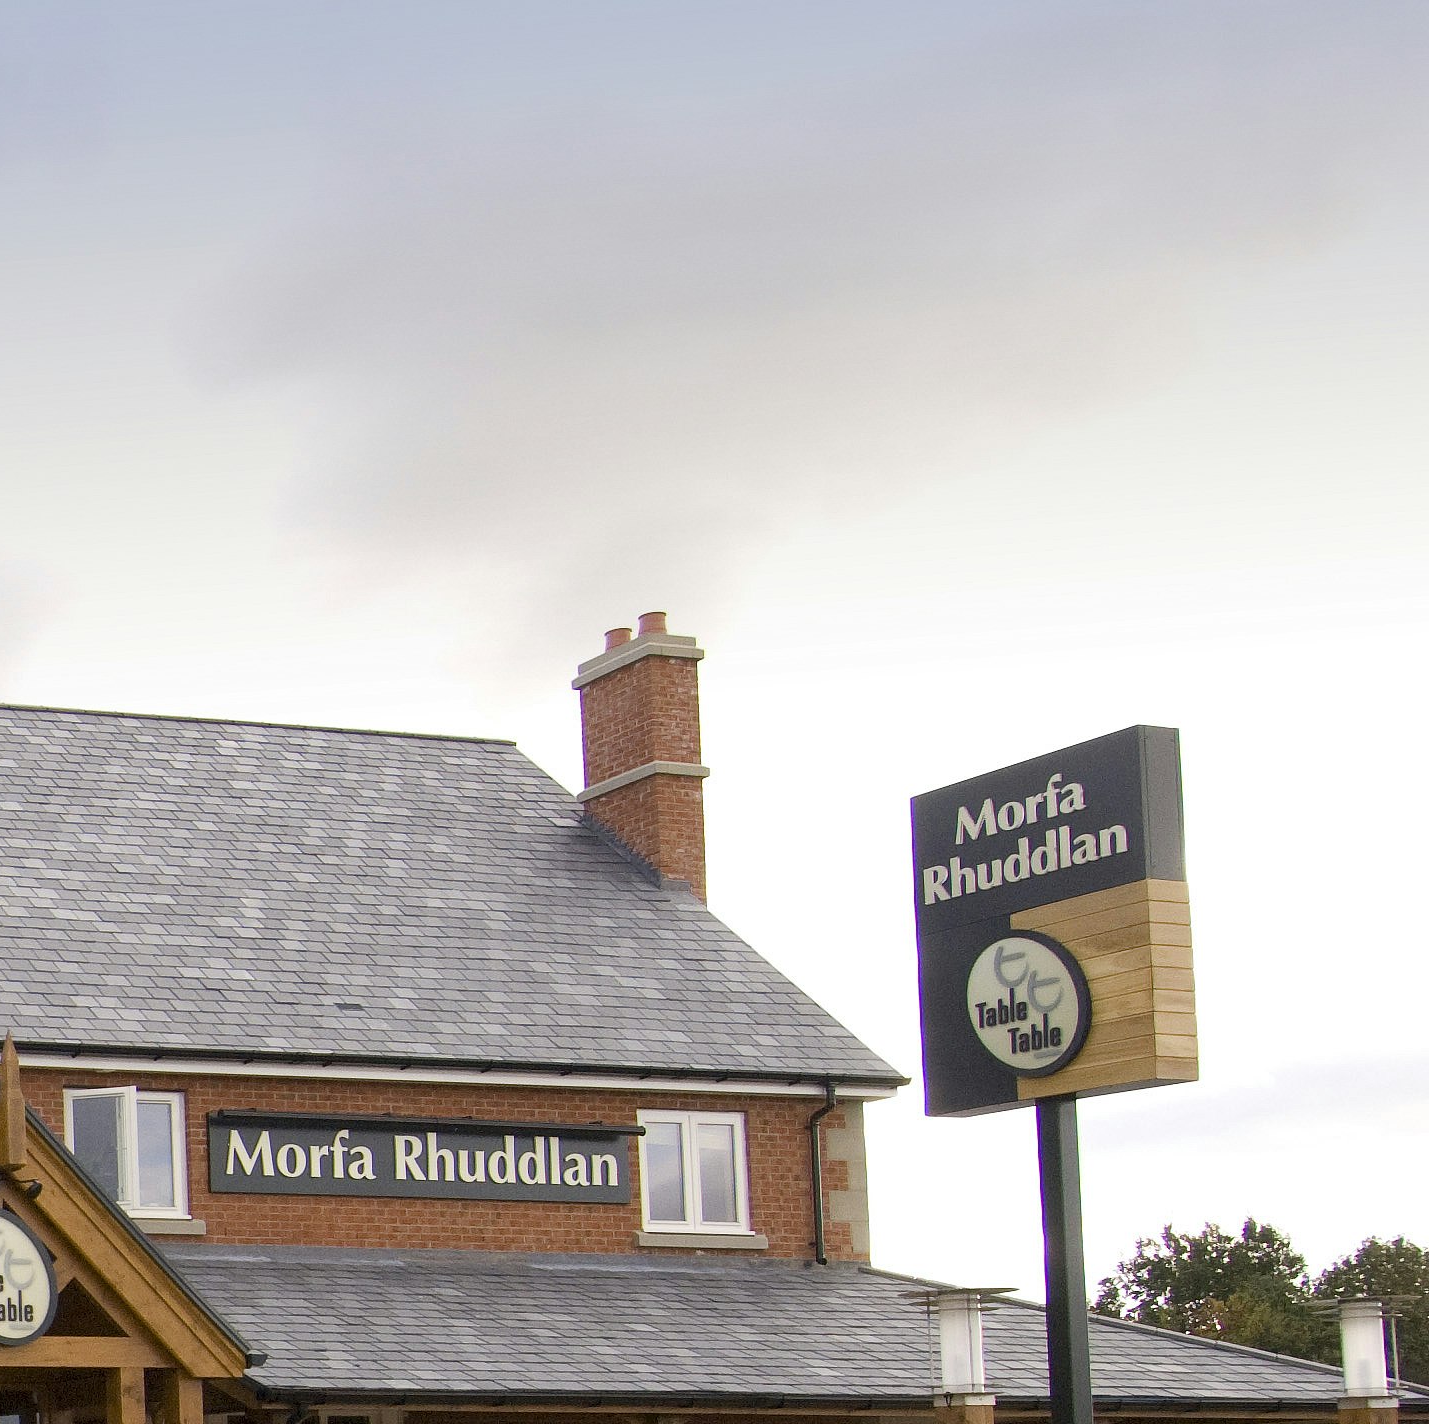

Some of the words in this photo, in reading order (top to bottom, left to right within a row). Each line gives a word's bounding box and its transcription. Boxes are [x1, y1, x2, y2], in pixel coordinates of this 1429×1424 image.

[955, 773, 1087, 845] Morfa
[923, 824, 1128, 905] Rhuddlan
[975, 988, 1027, 1030] Table
[1007, 1013, 1062, 1055] Table
[226, 1129, 376, 1180] Morfa
[394, 1132, 619, 1187] Rhuddlan
